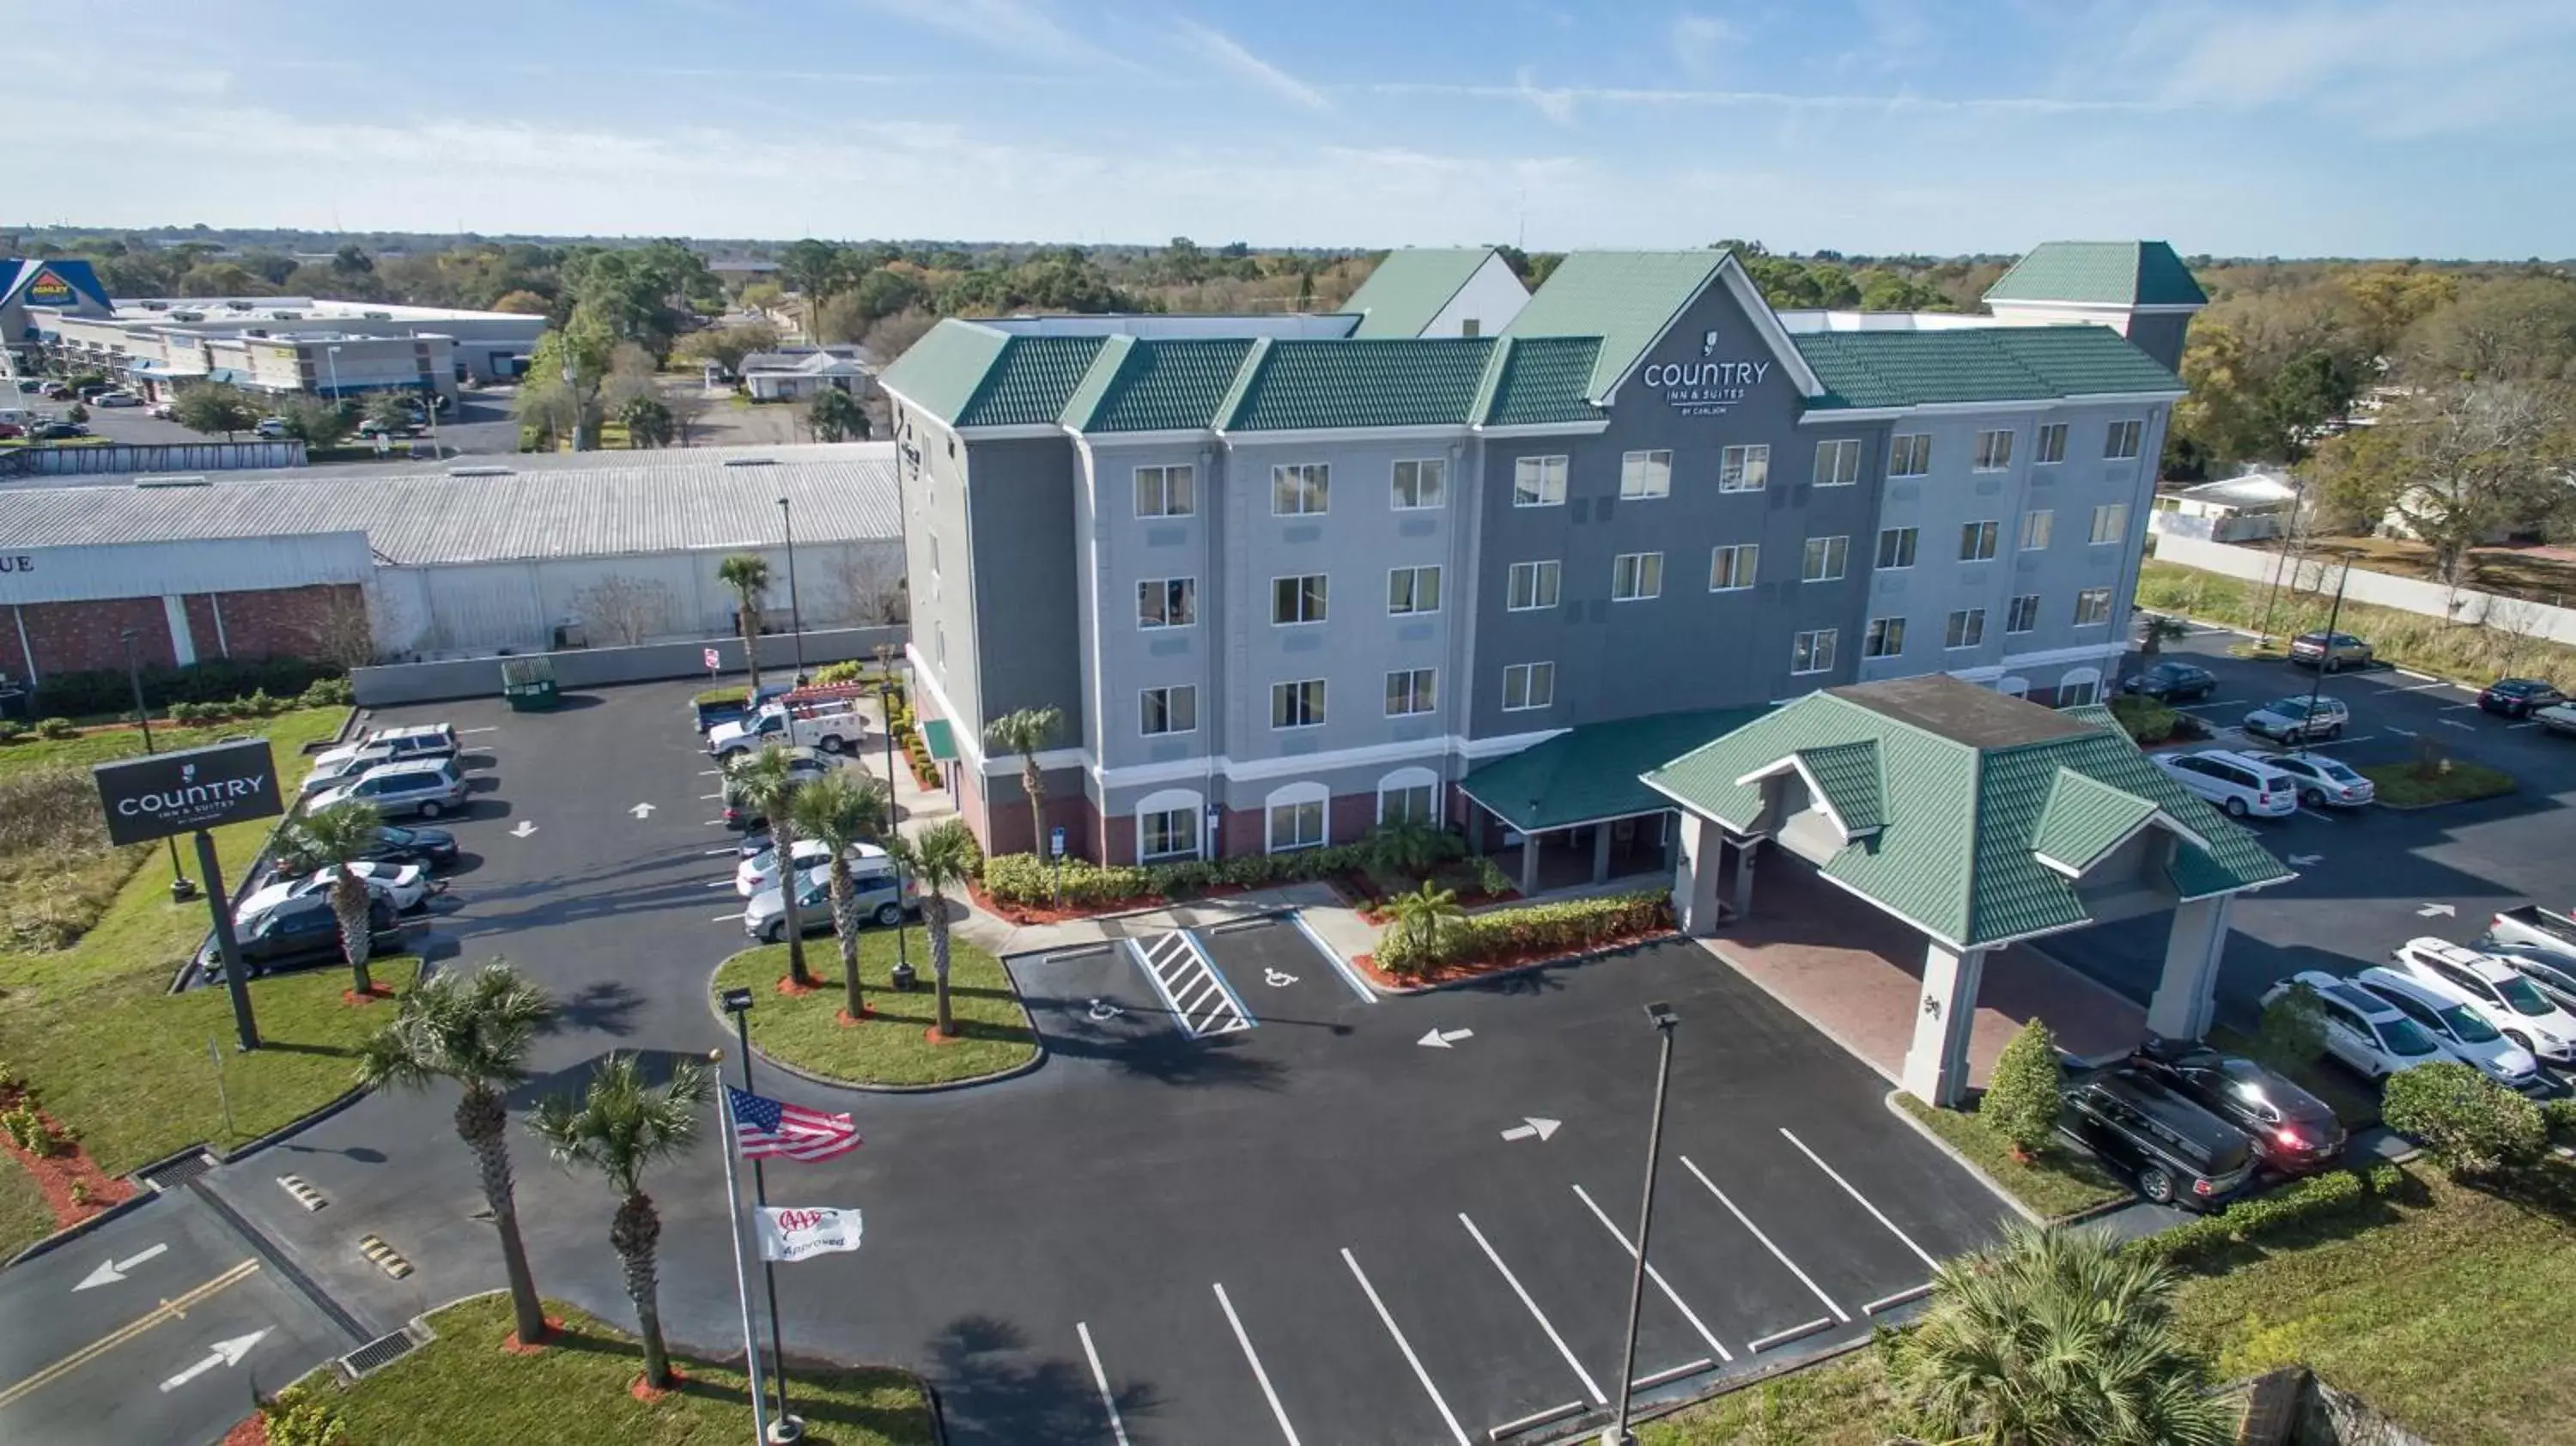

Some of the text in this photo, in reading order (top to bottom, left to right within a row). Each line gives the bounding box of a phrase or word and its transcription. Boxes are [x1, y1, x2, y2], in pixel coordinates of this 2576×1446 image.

[1643, 361, 1771, 387] COUNTRY
[1667, 390, 1687, 400] INN
[1703, 388, 1746, 400] SUITES
[118, 775, 264, 816] COUNTRY
[780, 1208, 822, 1231] AAA
[783, 1236, 845, 1258] Approved
